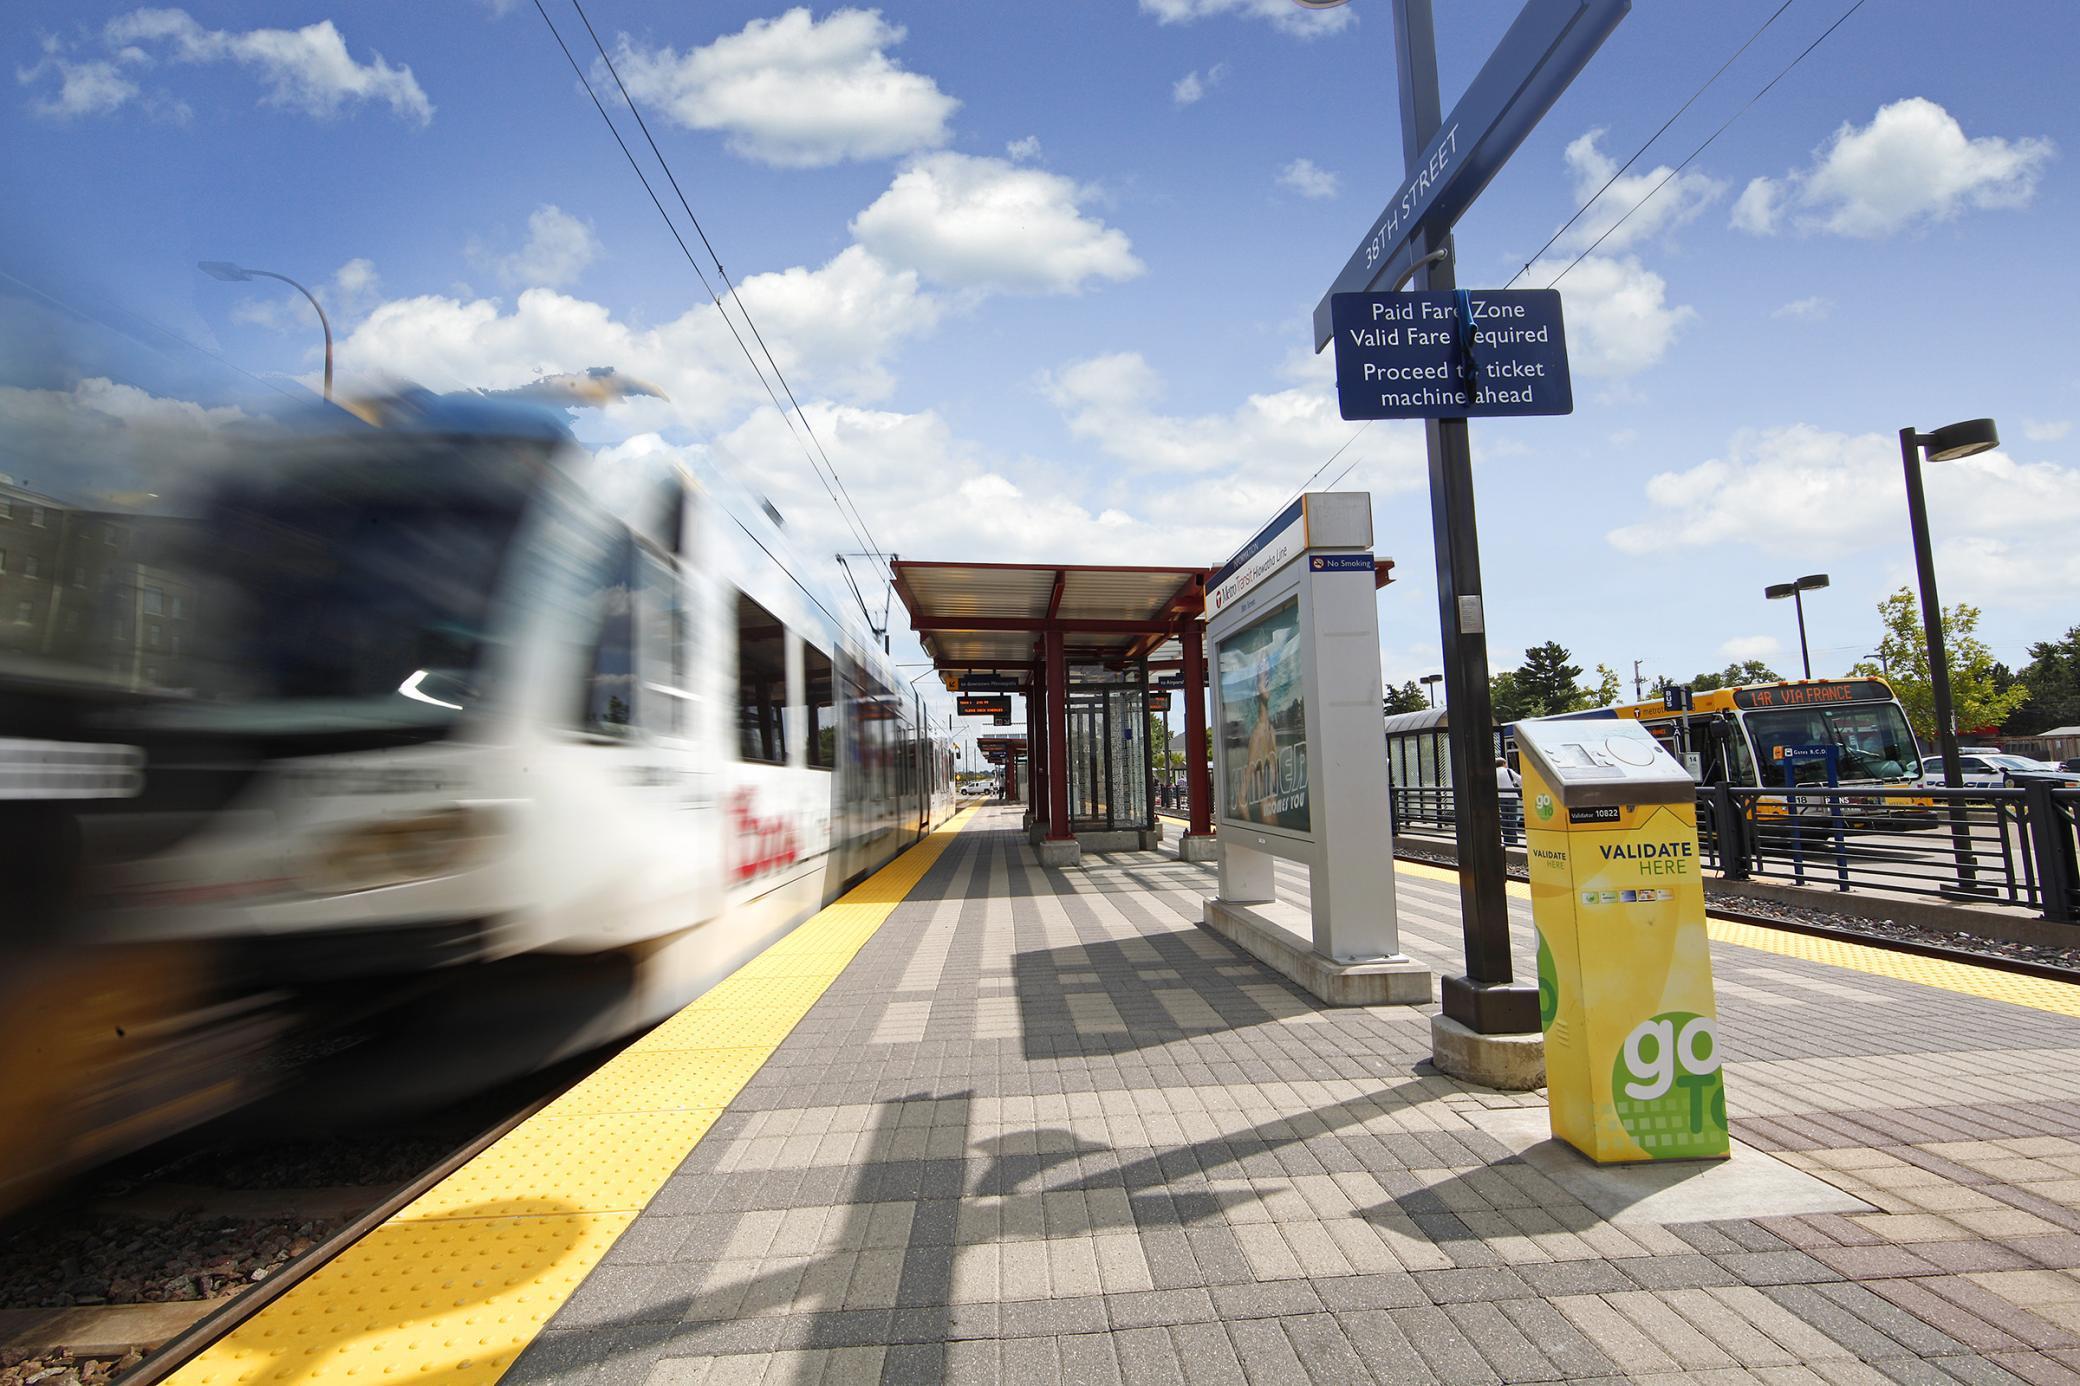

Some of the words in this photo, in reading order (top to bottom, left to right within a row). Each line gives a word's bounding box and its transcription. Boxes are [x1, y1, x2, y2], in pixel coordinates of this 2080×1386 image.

[1365, 208, 1399, 270] 38TH
[1402, 122, 1460, 220] STREET
[1372, 302, 1414, 321] Paid
[1471, 301, 1526, 318] Zone
[1350, 328, 1400, 347] Valid
[1407, 327, 1451, 345] Fare
[1473, 325, 1549, 349] equired
[1363, 361, 1449, 381] Proceed
[1486, 360, 1545, 378] ticket
[1381, 387, 1467, 406] machine
[1475, 385, 1534, 404] ahead
[1236, 567, 1253, 592] Transit
[1276, 546, 1288, 562] Line
[1341, 559, 1371, 569] Smoking
[1665, 690, 1673, 707] BUS
[1751, 691, 1773, 706] 14R
[1781, 688, 1804, 704] VIA
[1806, 685, 1853, 704] FRANCE
[1290, 792, 1305, 810] YOU
[1536, 795, 1551, 809] go
[1595, 809, 1619, 818] 10822
[1533, 849, 1567, 860] VALIDATE
[1600, 842, 1693, 860] VALIDATE
[1546, 860, 1565, 870] HERE
[1639, 859, 1688, 875] HERE
[1624, 1017, 1722, 1100] go
